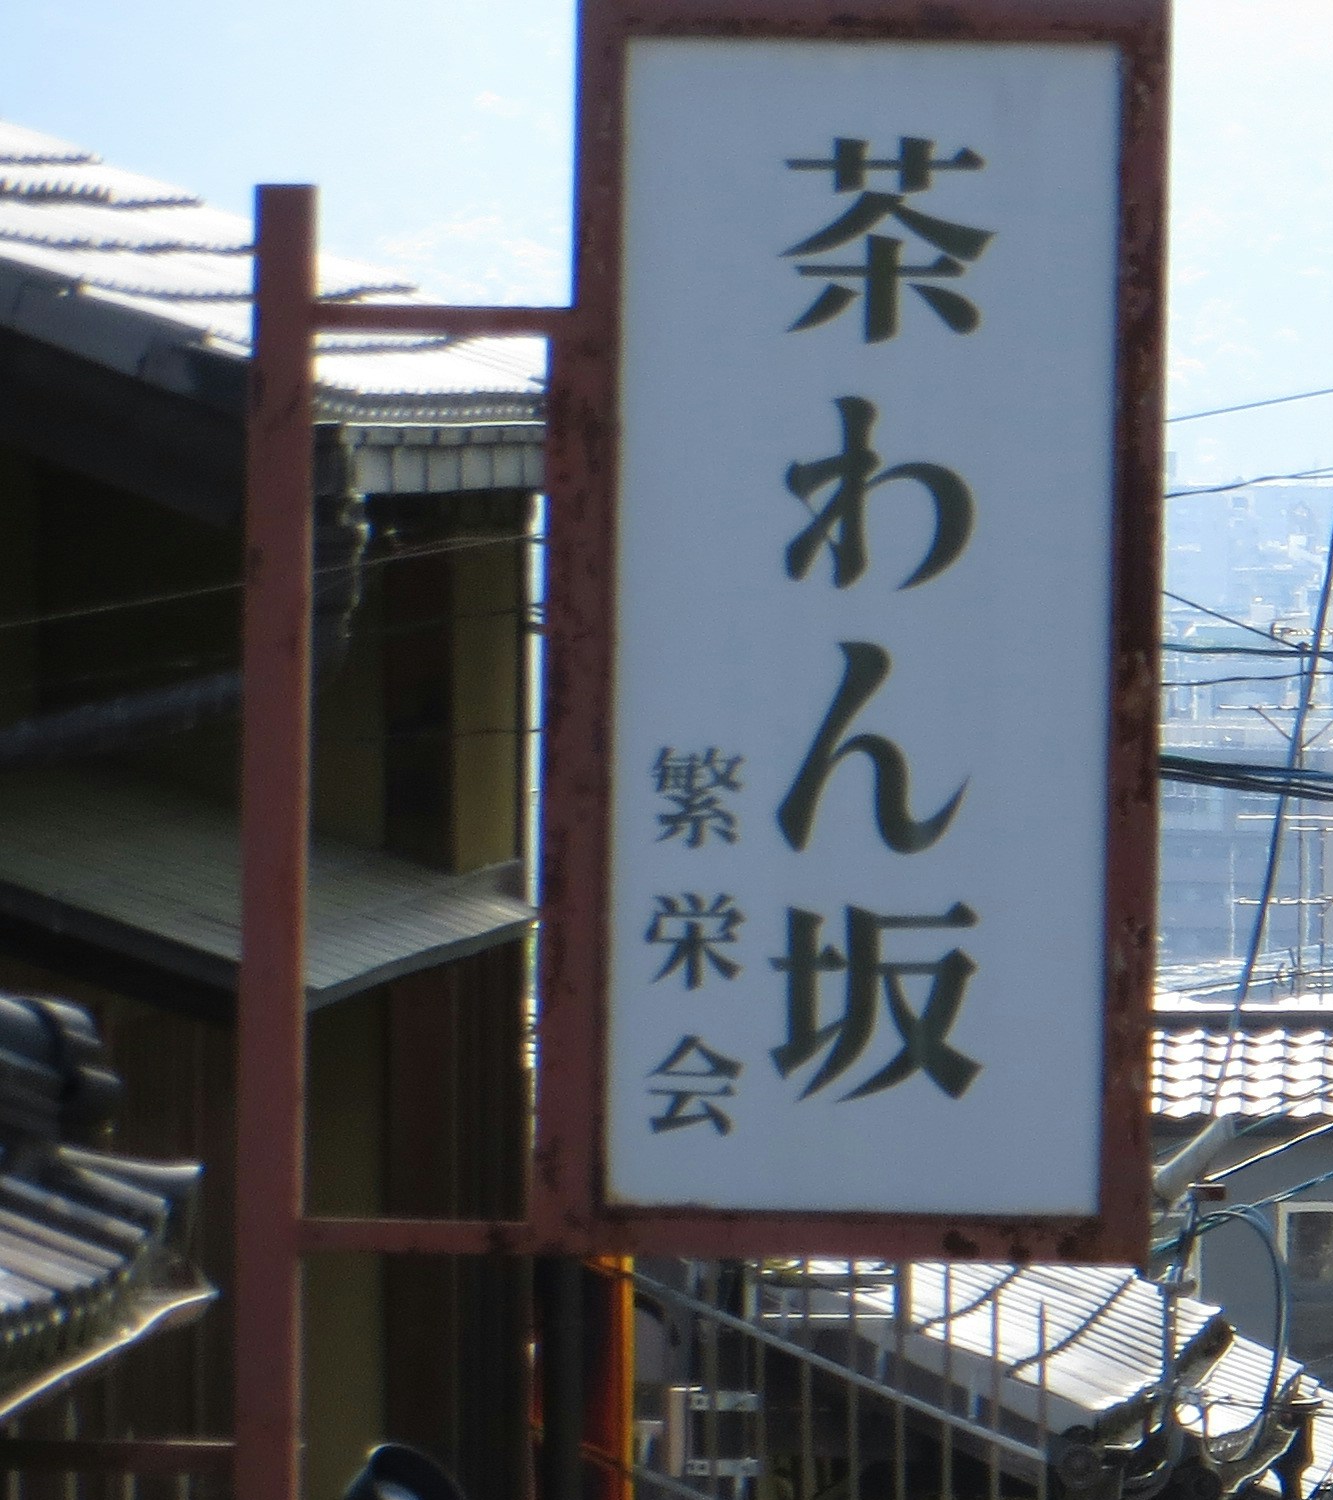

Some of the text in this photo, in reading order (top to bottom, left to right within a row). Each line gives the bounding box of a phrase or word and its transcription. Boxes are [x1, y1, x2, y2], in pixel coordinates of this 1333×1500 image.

[645, 746, 745, 1136] 繁栄会
[769, 135, 996, 1103] 茶わん坂
